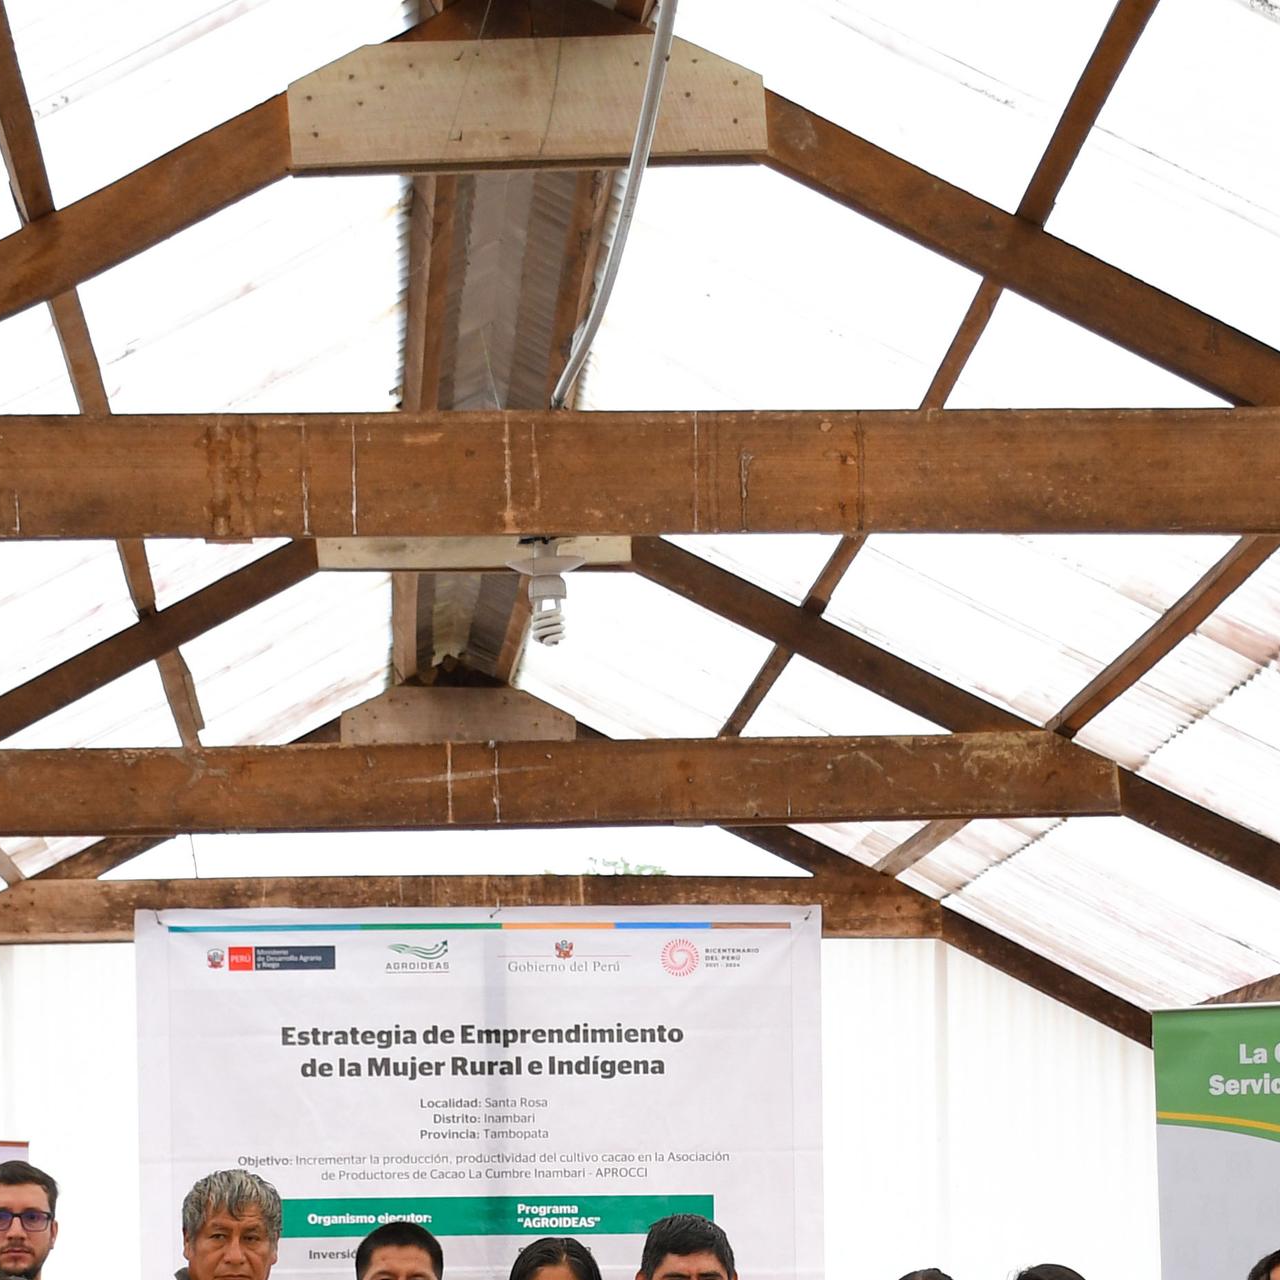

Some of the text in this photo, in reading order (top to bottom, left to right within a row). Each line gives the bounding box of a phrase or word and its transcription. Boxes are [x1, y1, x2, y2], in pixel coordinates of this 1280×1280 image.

[704, 947, 760, 955] BICENTENARIO
[230, 953, 251, 964] PERÚ
[385, 961, 450, 971] AGROIDEAS
[507, 959, 621, 973] Gobierno del Perú
[281, 1023, 684, 1049] Estrategia de Emprendimiento
[1239, 1043, 1268, 1064] La
[300, 1054, 666, 1081] de la Mujer Rural e Indígena
[420, 1097, 548, 1110] Localidad: Santa Rosa
[432, 1112, 536, 1125] Distrito: Inambari
[420, 1128, 550, 1142] Provincia: Tambopata
[238, 1150, 730, 1170] Objetivo: Incrementar la producción, productividad del cultivo cacao en la Asociación
[320, 1166, 648, 1182] de Productores de Cacao La Cumbre Inambari APROCCI
[517, 1203, 579, 1218] Programa
[307, 1214, 376, 1225] Organismo
